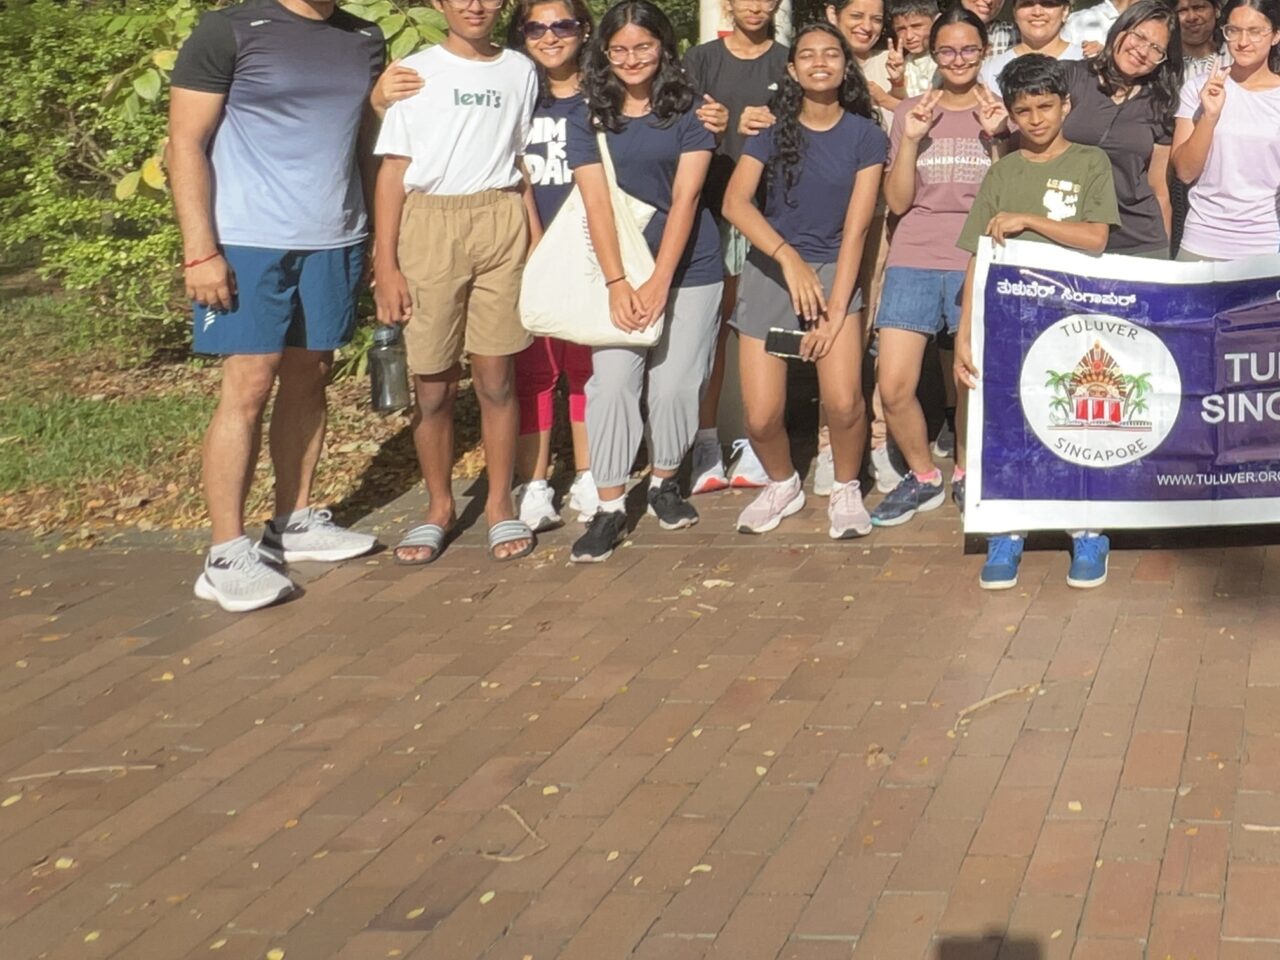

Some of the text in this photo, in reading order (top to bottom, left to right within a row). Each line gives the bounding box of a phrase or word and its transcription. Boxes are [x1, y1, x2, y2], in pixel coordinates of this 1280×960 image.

[453, 88, 502, 109] levi's
[1060, 320, 1139, 340] TULUVER
[1054, 437, 1148, 461] SINGAPORE
